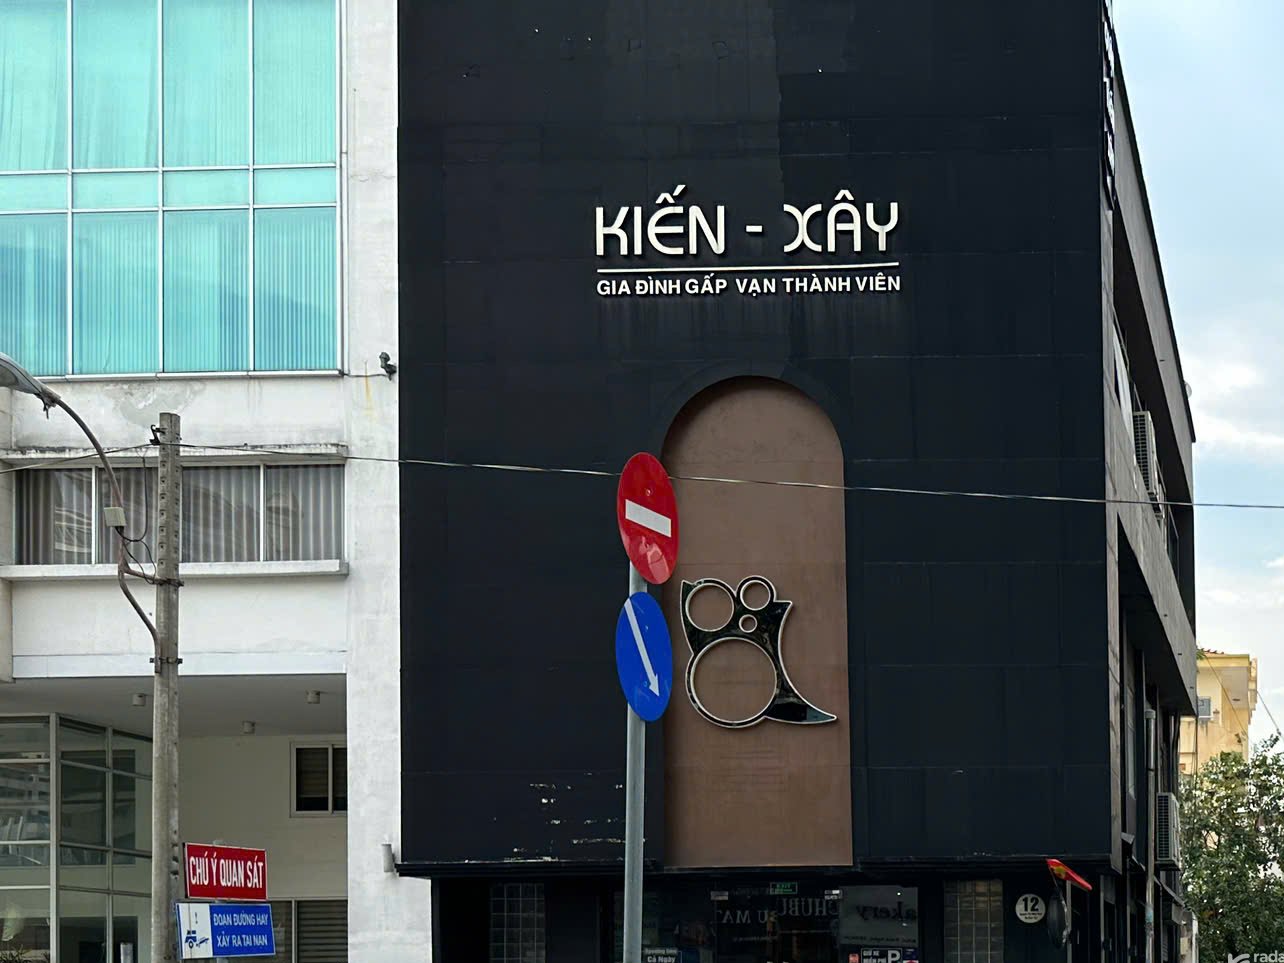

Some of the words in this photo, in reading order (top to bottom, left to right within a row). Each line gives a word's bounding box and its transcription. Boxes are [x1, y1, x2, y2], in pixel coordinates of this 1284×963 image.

[595, 184, 725, 256] KIẾN
[783, 189, 899, 253] XÂY
[596, 279, 632, 296] GIA
[635, 275, 681, 295] ĐÌNH
[684, 272, 728, 294] GẤP
[735, 277, 777, 297] VẠN
[782, 273, 851, 293] THÀNH
[855, 272, 901, 291] VIÊN
[189, 851, 209, 886] CHÚ
[211, 852, 217, 886] Ý
[220, 858, 245, 888] QUAN
[246, 856, 264, 889] SÁT
[1022, 896, 1040, 912] 12
[256, 913, 269, 926] HAY
[232, 934, 242, 947] RA
